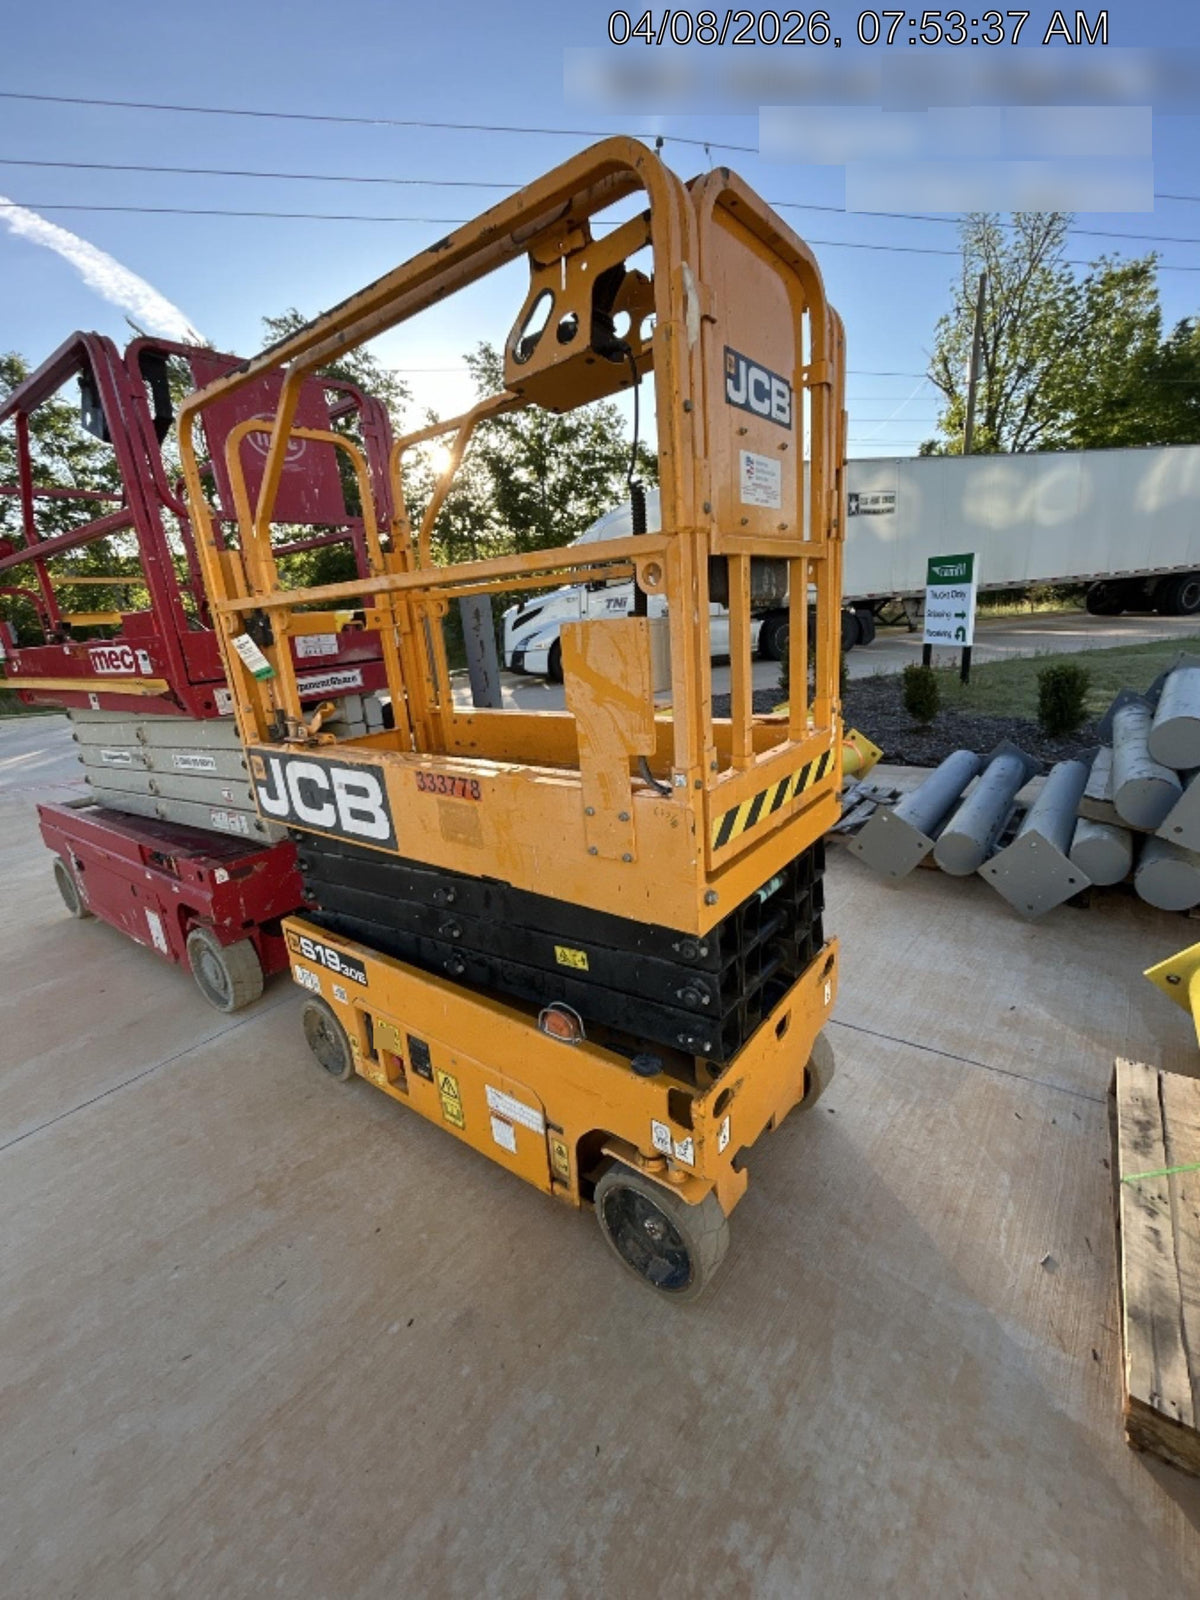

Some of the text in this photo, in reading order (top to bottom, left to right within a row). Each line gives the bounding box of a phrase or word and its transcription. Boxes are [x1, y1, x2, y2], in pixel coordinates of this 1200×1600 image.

[726, 359, 791, 424] JCB
[926, 628, 951, 639] Receiving
[90, 648, 135, 671] mec
[257, 758, 391, 841] JCB
[415, 770, 481, 800] 333778
